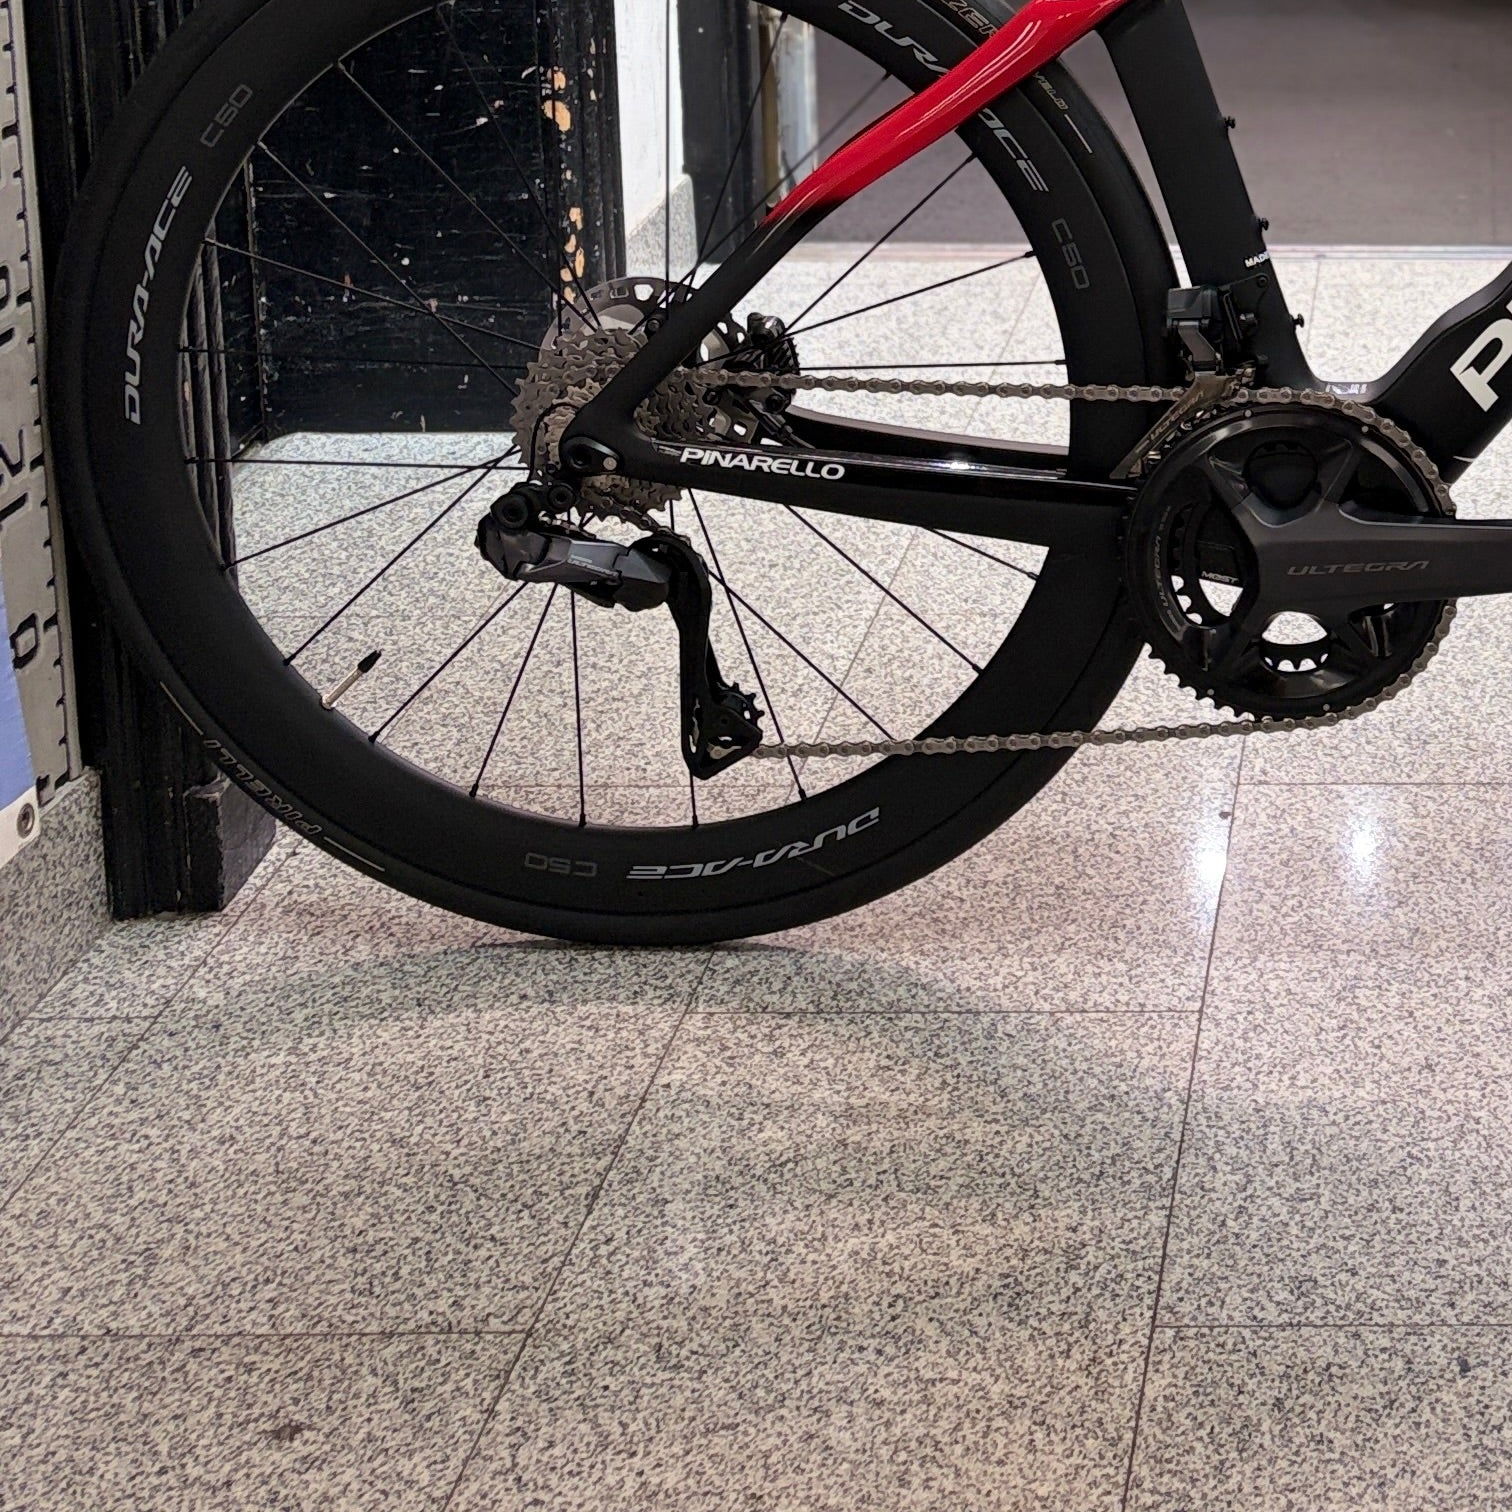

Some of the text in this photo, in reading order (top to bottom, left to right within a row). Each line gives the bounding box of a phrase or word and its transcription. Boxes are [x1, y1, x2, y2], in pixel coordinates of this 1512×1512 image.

[125, 85, 253, 426] DURA-ACE C50
[1052, 218, 1090, 289] C50
[680, 447, 846, 480] PINARELLO
[1287, 560, 1430, 576] ULTEGRA
[203, 739, 322, 835] PIRELLI
[524, 806, 879, 879] DURA-ACE C50
